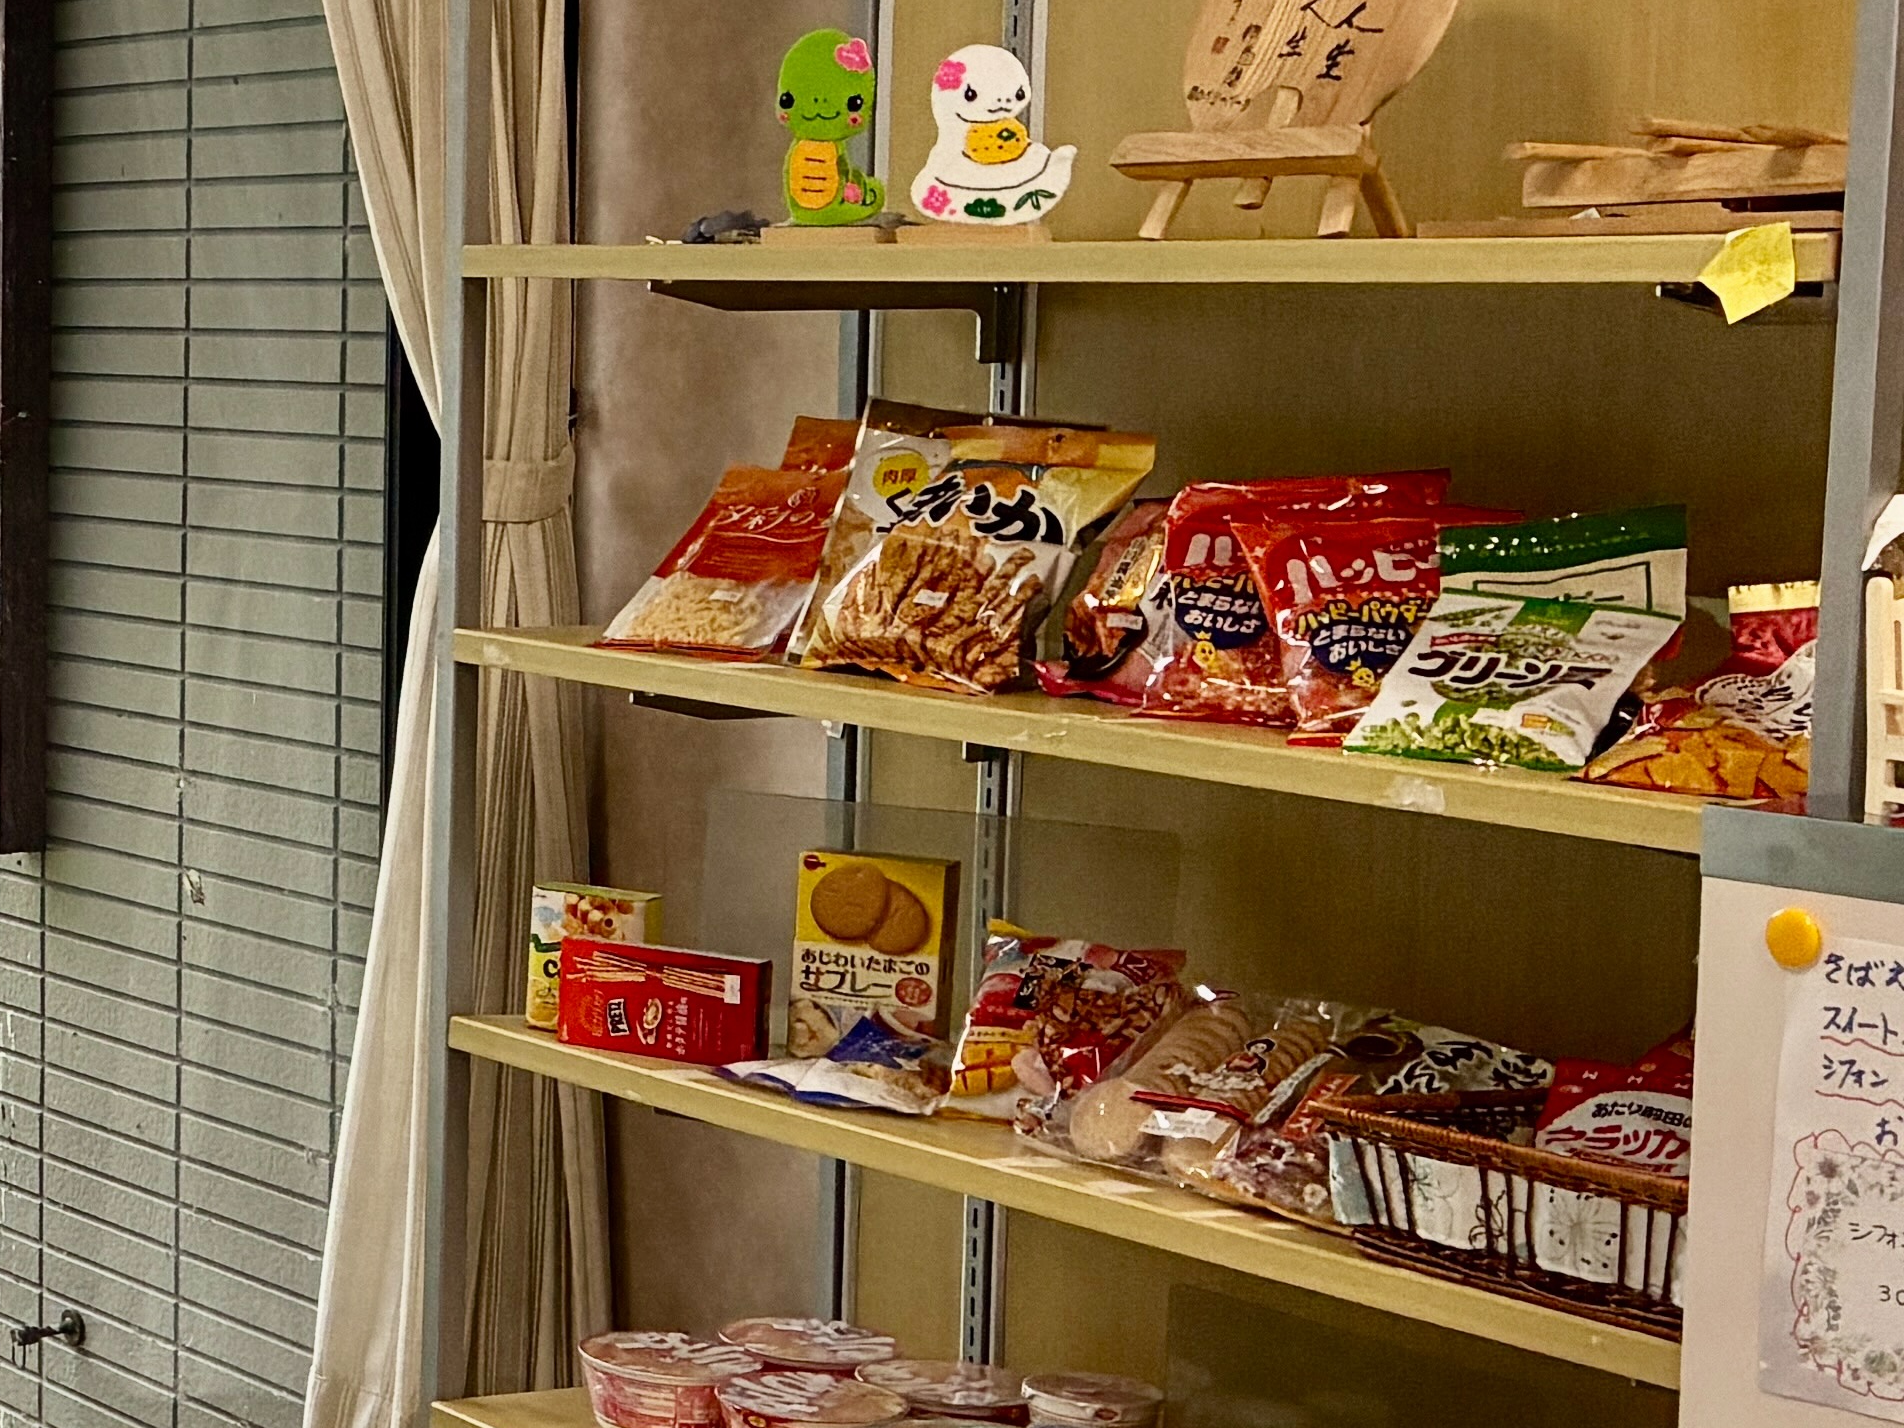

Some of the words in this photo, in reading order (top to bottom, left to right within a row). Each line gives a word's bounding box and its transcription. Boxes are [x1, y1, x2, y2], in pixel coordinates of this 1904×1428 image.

[801, 948, 931, 976] あじわいたまごの
[1848, 1222, 1904, 1250] シフォ
